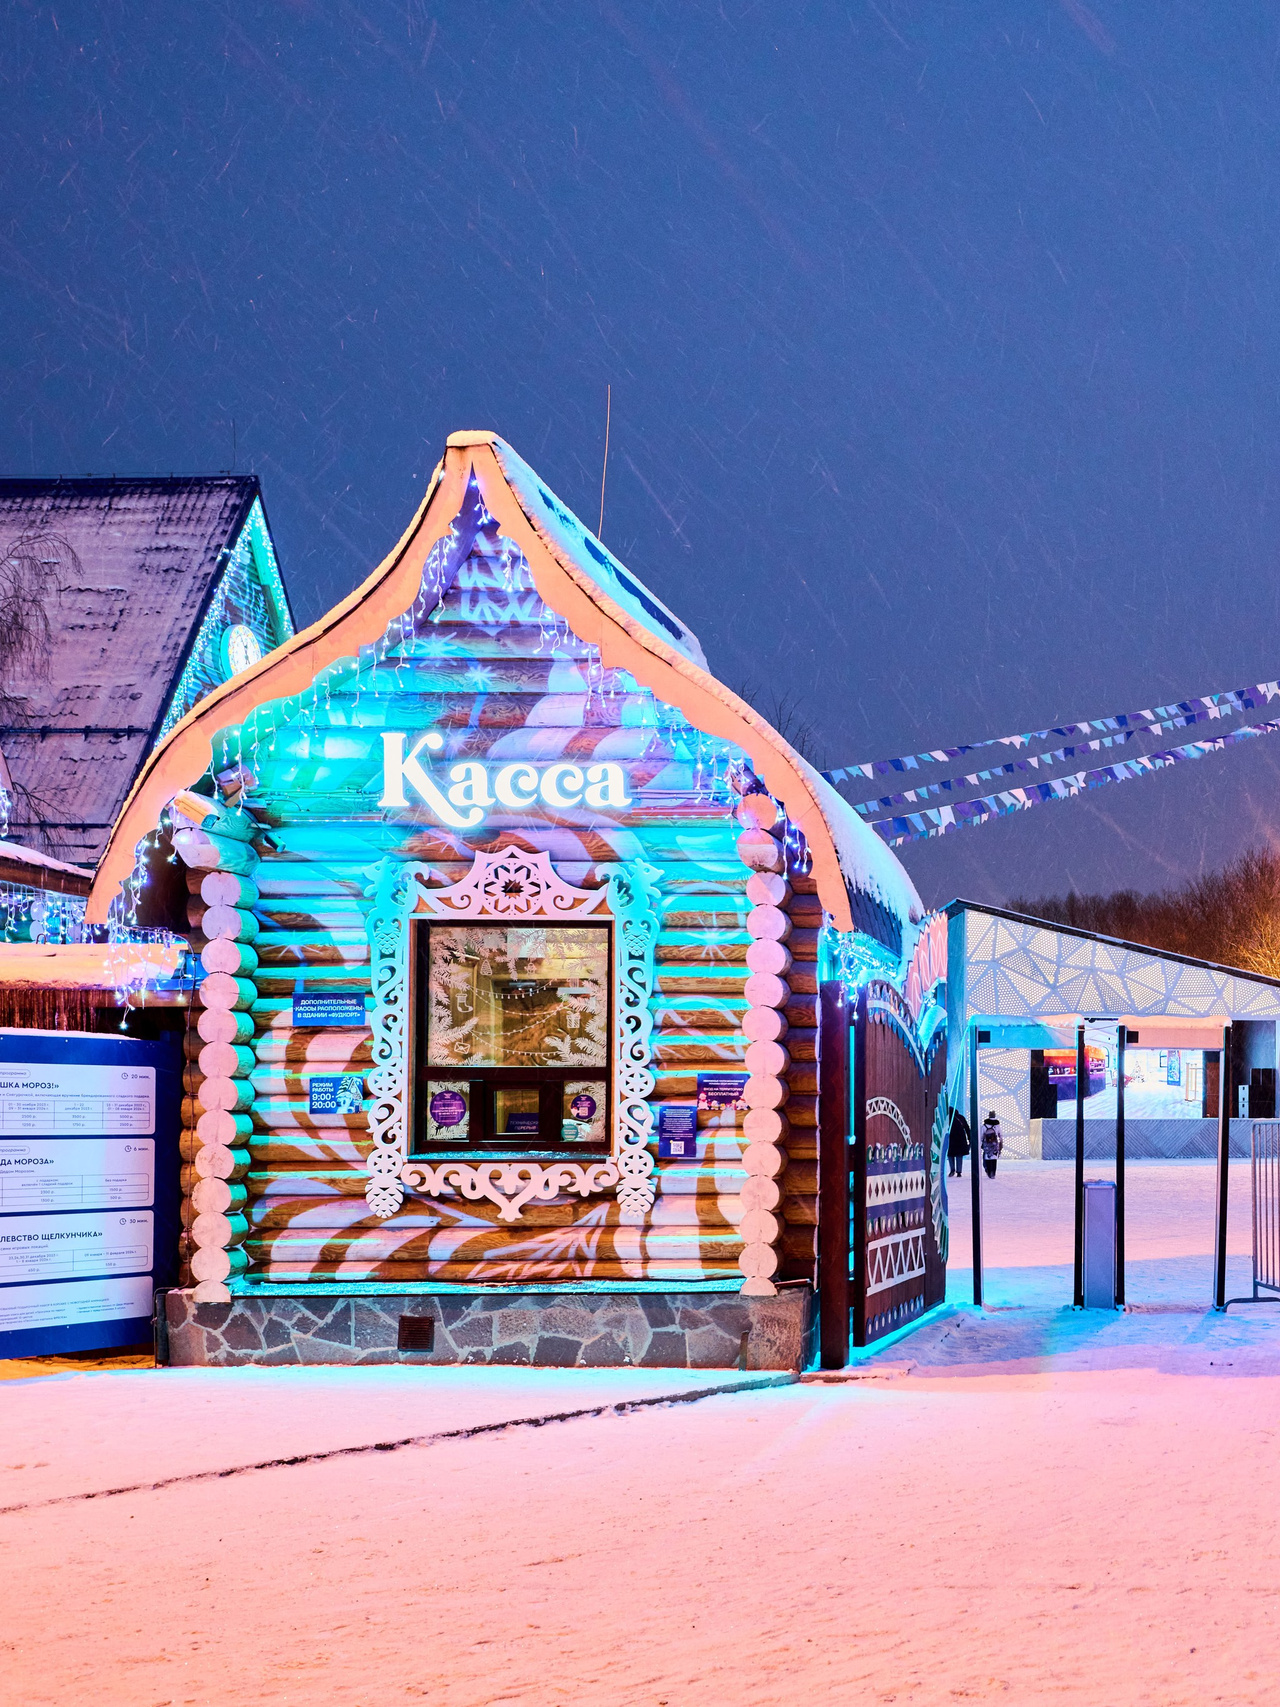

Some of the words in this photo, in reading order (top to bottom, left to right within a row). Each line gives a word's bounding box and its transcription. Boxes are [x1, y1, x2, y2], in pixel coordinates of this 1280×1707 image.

[377, 732, 633, 827] Касса
[0, 1234, 39, 1242] ЛЕВСТВО
[42, 1231, 103, 1241] ЩЕЛКУНЧИКА»
